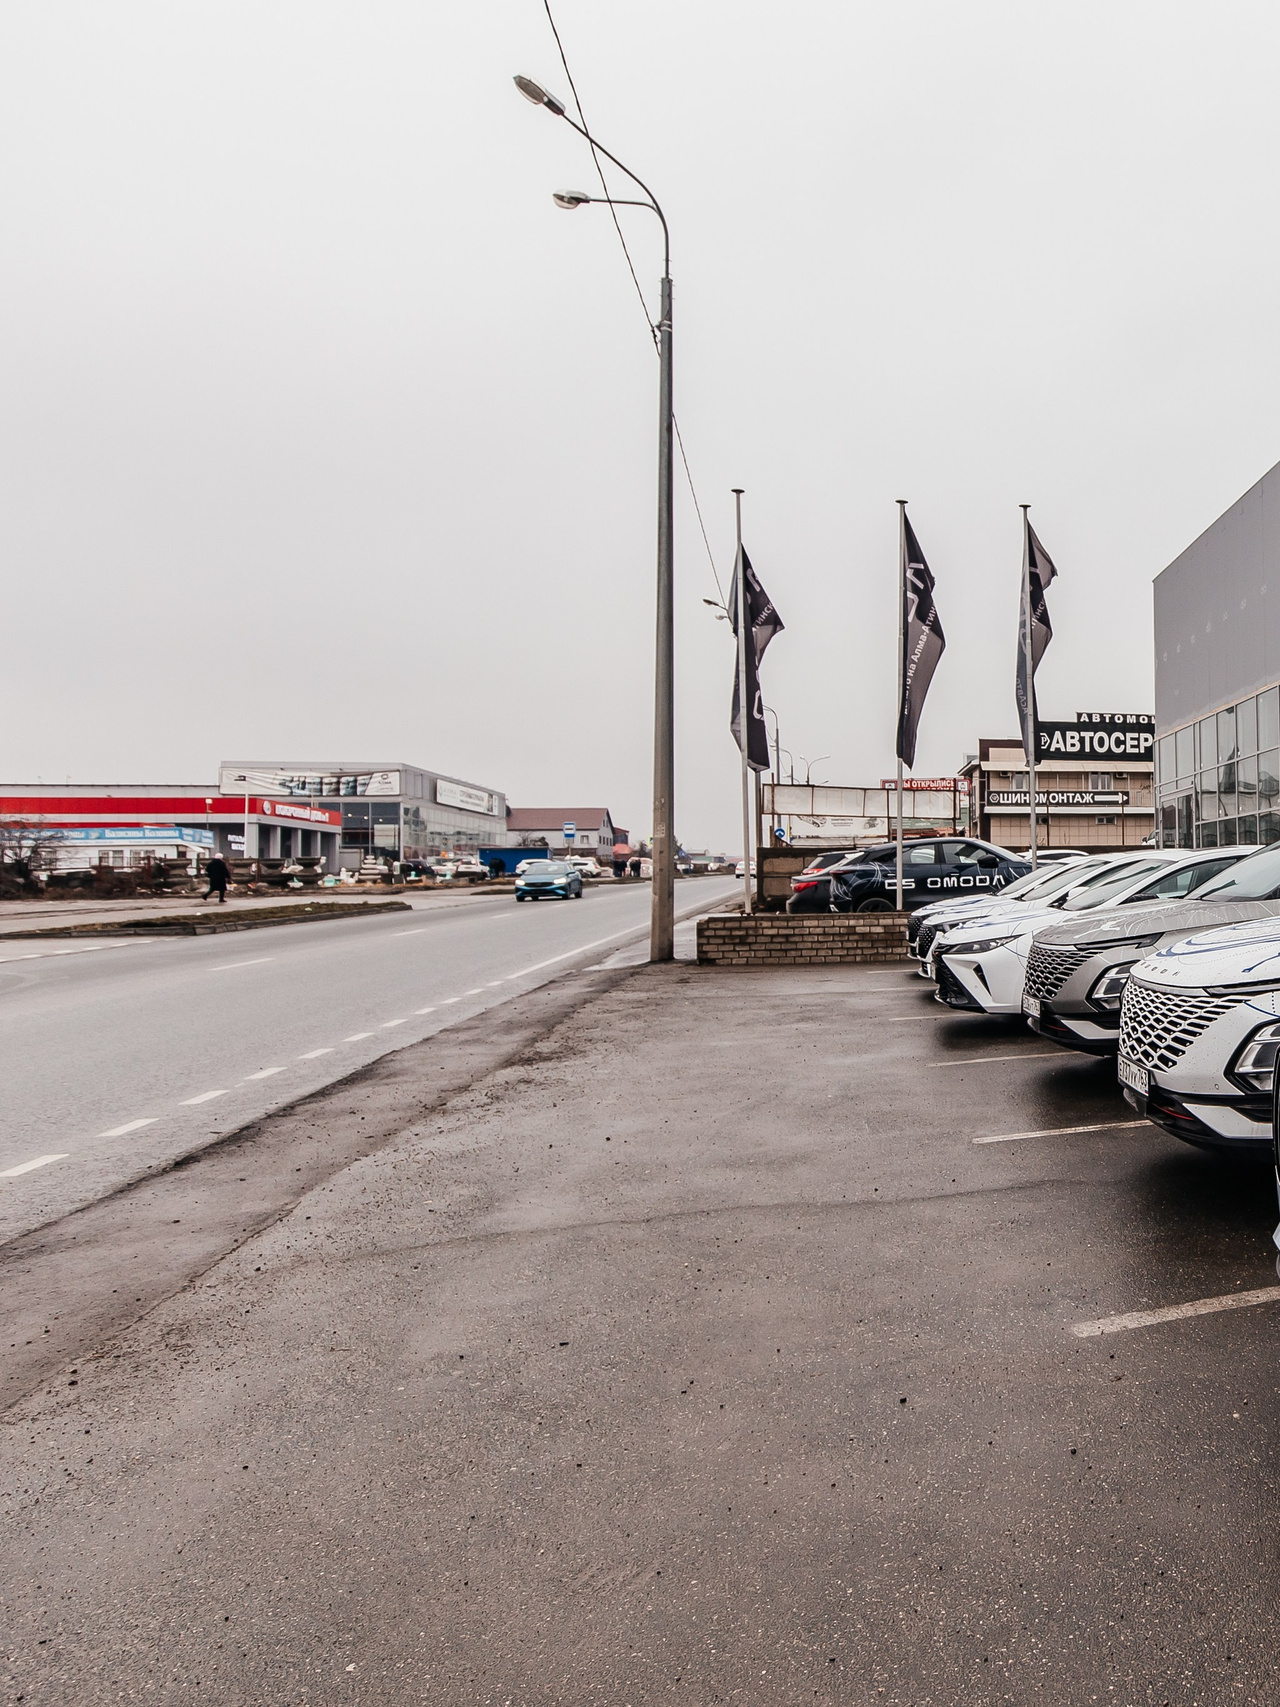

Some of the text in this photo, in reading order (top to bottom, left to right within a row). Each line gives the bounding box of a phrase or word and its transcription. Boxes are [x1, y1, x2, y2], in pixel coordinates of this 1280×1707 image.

[1080, 713, 1155, 724] АВТОМО
[1049, 730, 1153, 754] АВТОСЕР
[926, 875, 1006, 889] OMODA
